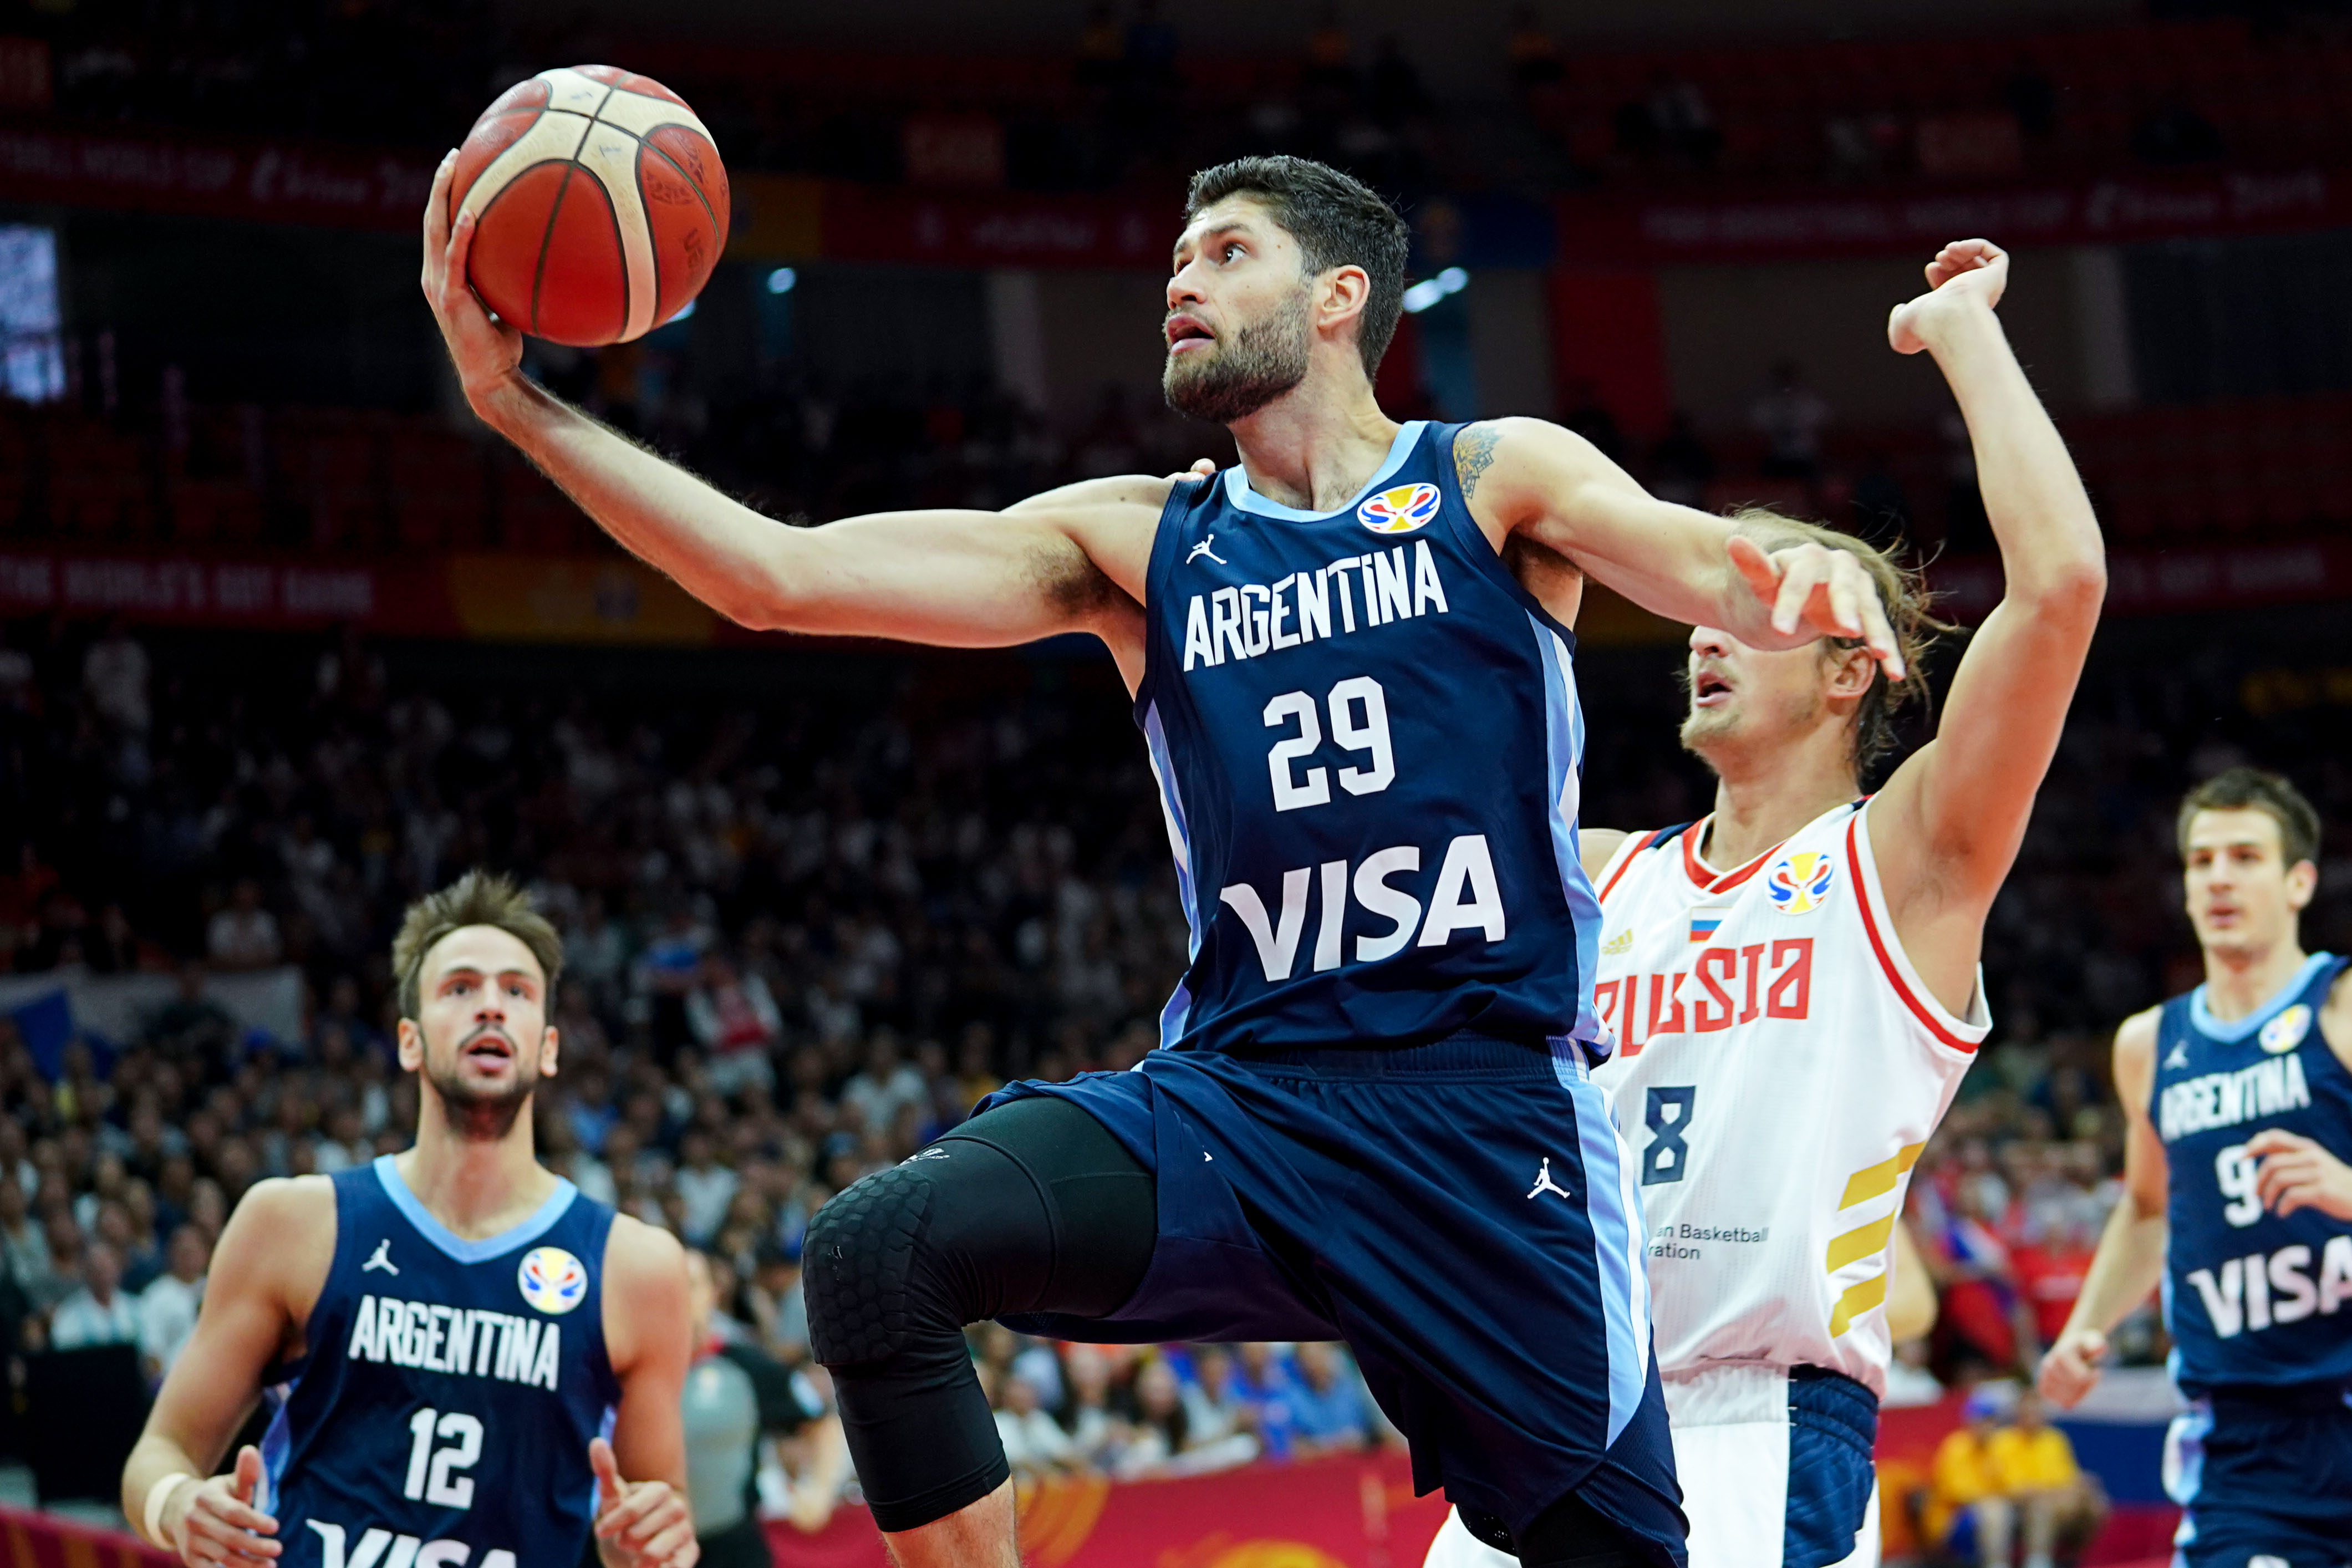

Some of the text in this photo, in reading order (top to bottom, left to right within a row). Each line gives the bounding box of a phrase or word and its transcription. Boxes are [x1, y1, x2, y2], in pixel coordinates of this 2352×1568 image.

[1184, 539, 1448, 671] ARGENTINA
[1264, 676, 1394, 811] 29
[1220, 834, 1505, 981] VISA
[1642, 1086, 1696, 1185] 8
[2160, 1052, 2311, 1143] ARGENTINA
[1680, 1224, 1769, 1242] Basketball
[2214, 1143, 2264, 1228] 9
[2187, 1235, 2352, 1340] VISA
[349, 1295, 559, 1391] ARGENTINA
[404, 1407, 484, 1509] 12
